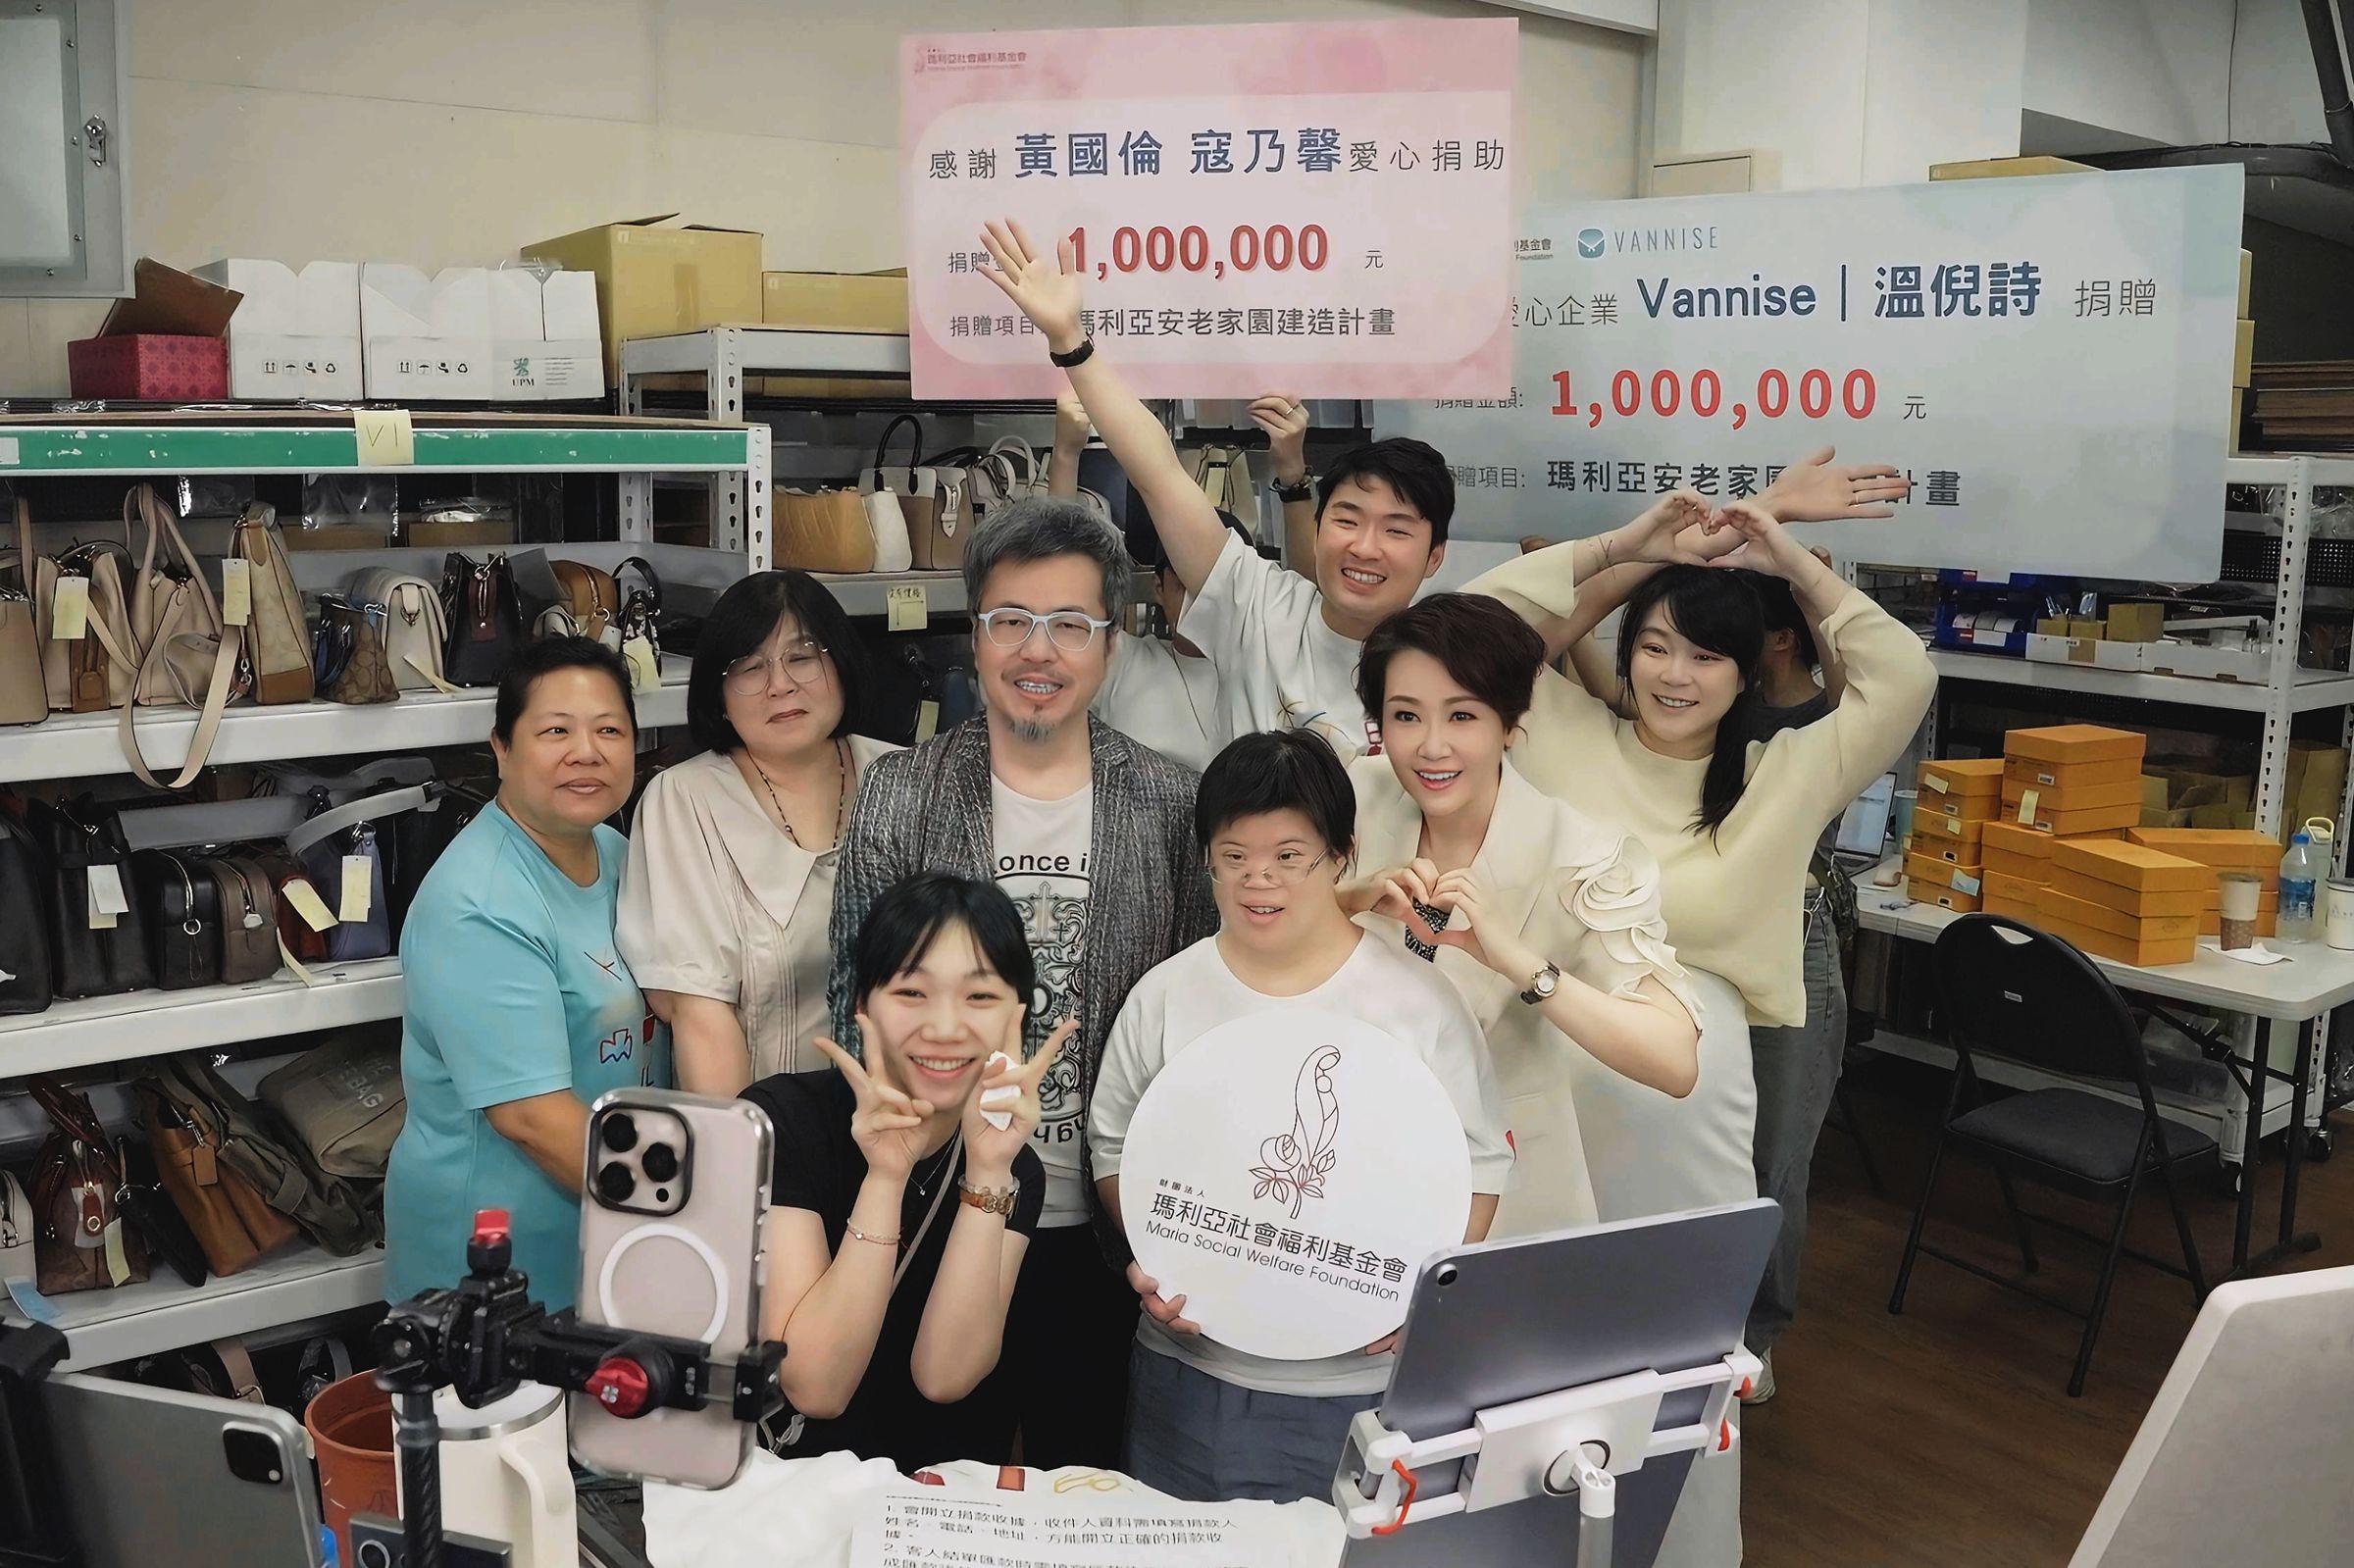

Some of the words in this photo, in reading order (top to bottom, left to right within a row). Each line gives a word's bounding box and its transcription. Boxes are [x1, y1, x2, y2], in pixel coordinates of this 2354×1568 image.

[929, 148, 997, 179] 感謝
[1014, 130, 1163, 178] 黃國倫
[1190, 127, 1342, 175] 寇乃馨
[1349, 139, 1505, 173] 愛心捐助
[1067, 224, 1329, 281] 1,000,000
[1364, 249, 1385, 270] 元
[1614, 227, 1718, 253] VANNISE
[1636, 276, 1817, 319] Vannise
[1873, 262, 2042, 319] 溫倪詩
[2074, 278, 2157, 318] 捐贈
[512, 378, 535, 387] UPM
[1551, 369, 1877, 430] 1,000,000
[1903, 395, 1927, 421] 元
[1547, 460, 1961, 507] 瑪利亞安老家畫
[998, 854, 1071, 873] once
[1159, 1178, 1205, 1199] 財團法人
[1151, 1192, 1408, 1284] 瑪利亞社會福利基金會
[1146, 1219, 1190, 1244] Maria
[1194, 1234, 1243, 1258] Social
[1247, 1247, 1305, 1277] Welfare
[1309, 1265, 1400, 1303] Foundation
